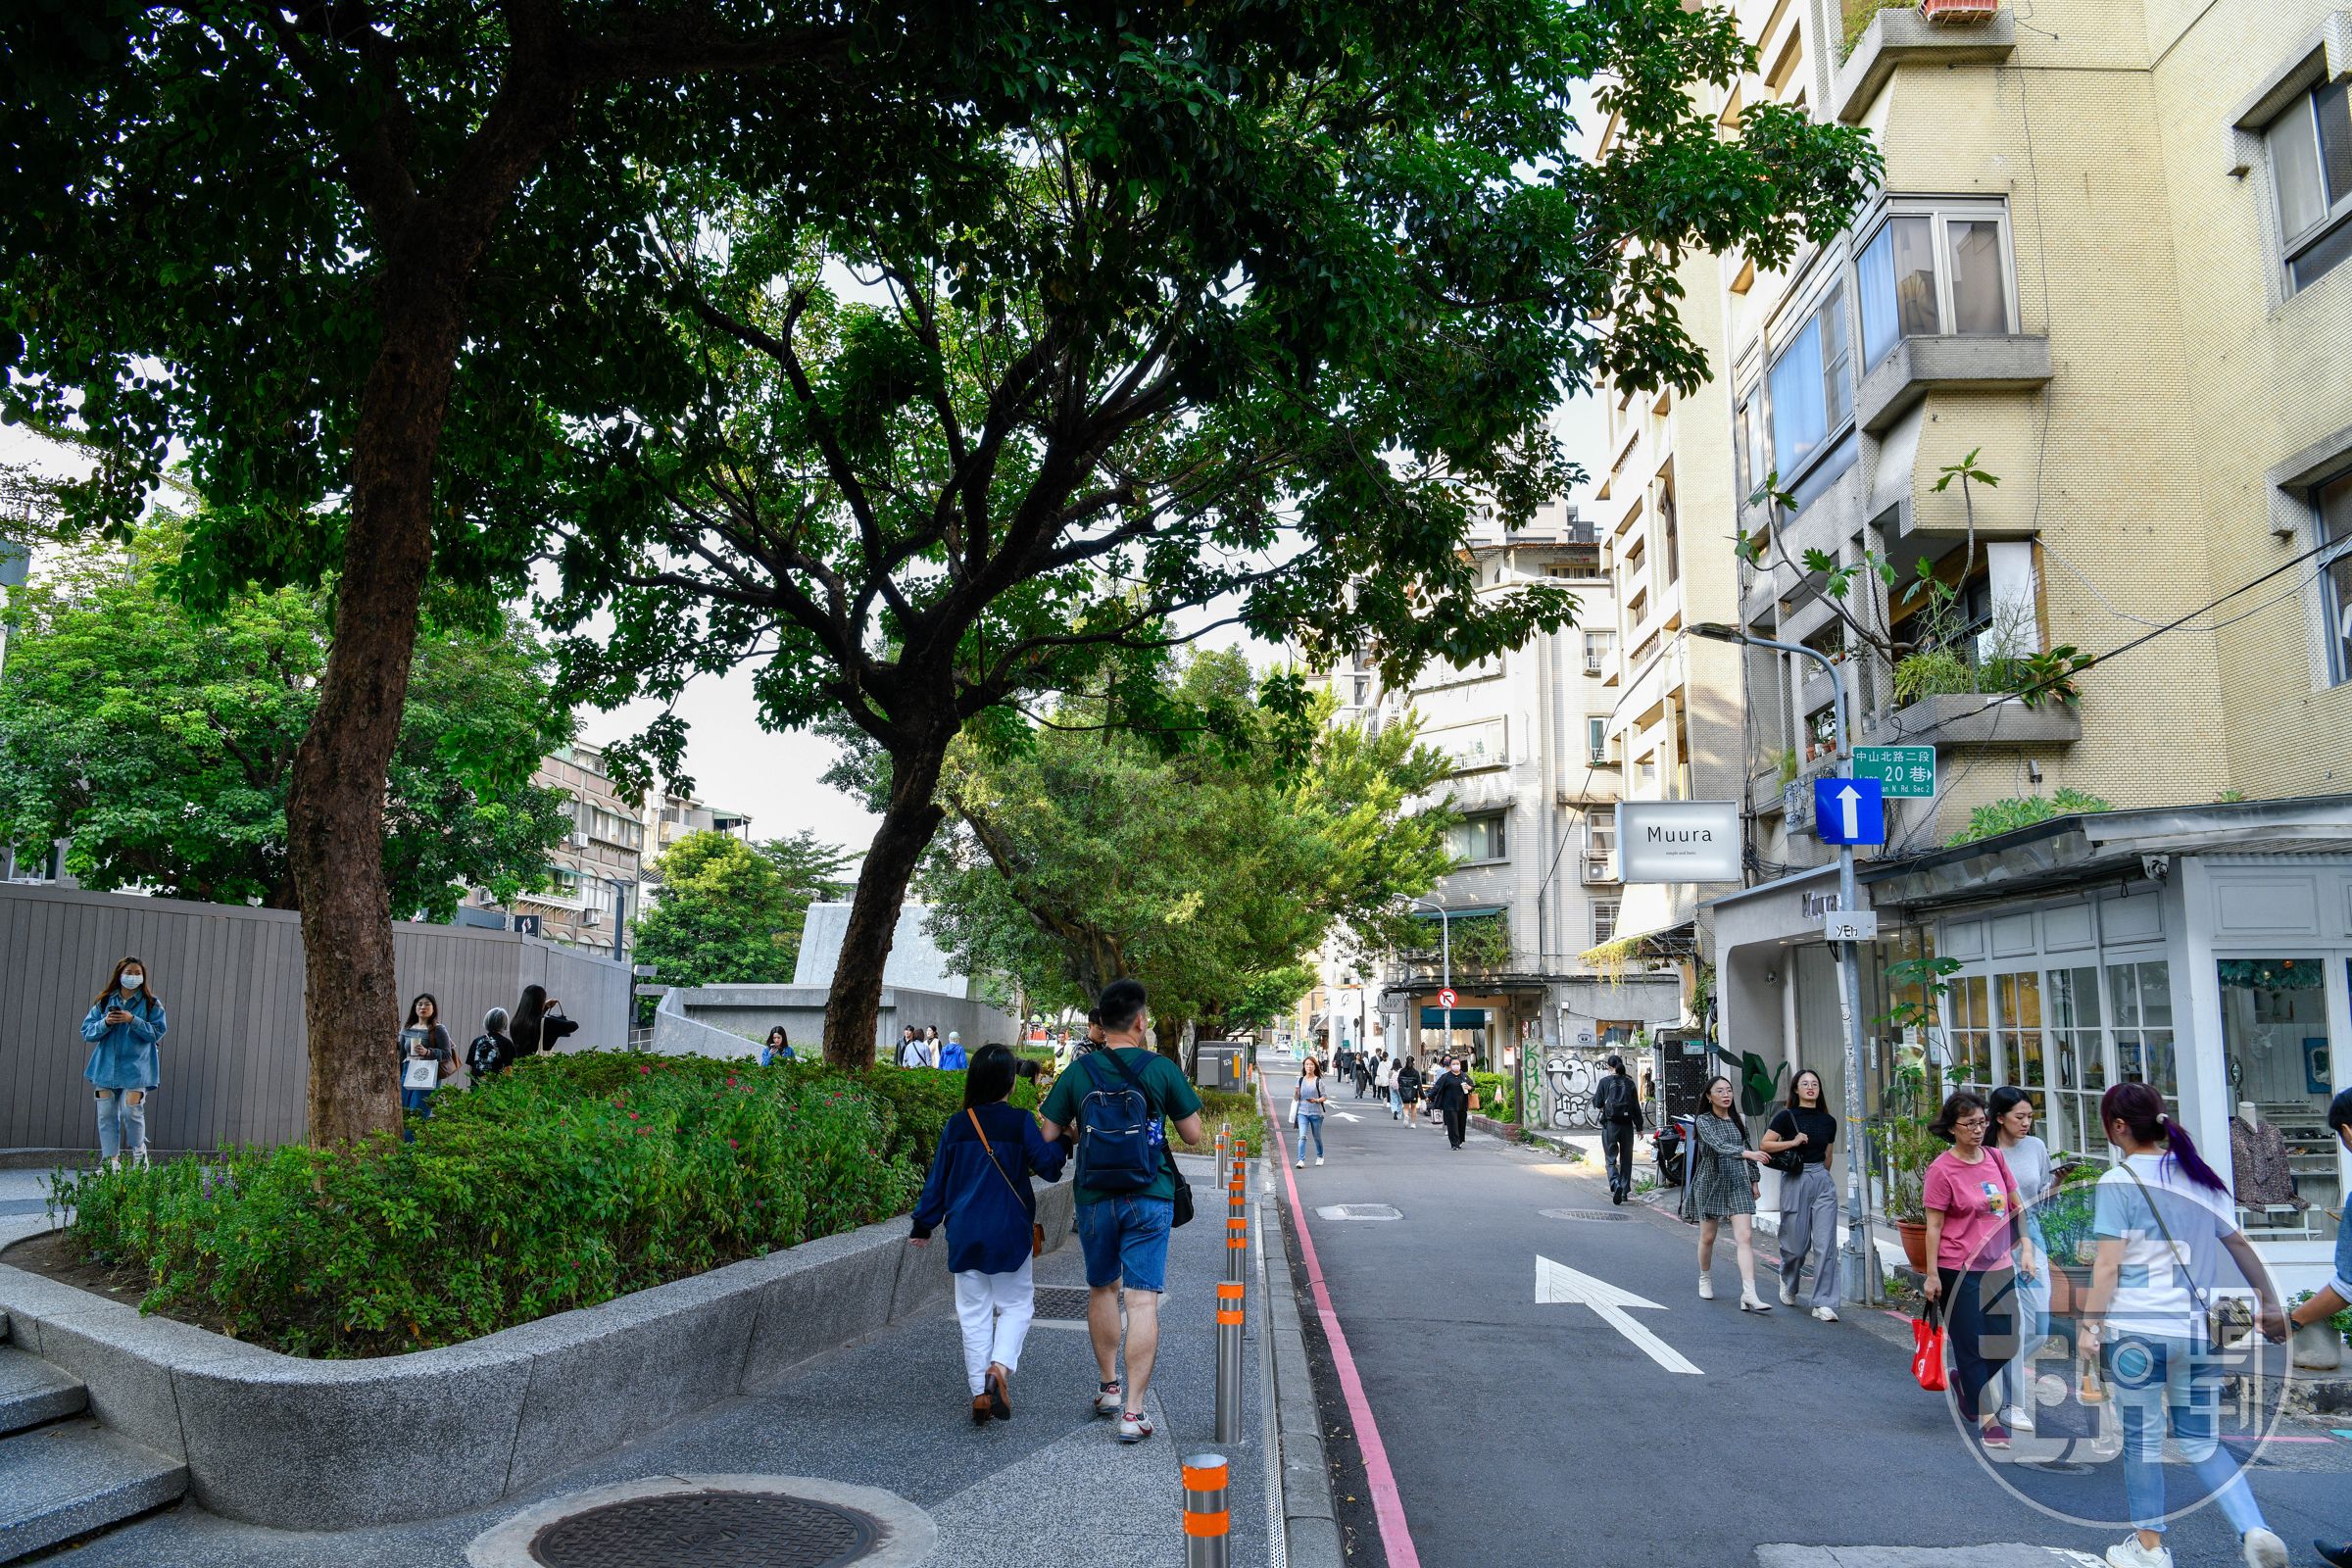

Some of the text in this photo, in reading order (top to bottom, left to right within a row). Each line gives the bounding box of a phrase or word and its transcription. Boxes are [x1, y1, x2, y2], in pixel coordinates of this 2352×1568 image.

[1856, 751, 1930, 762] 中山北路二段
[1885, 765, 1903, 782] 20
[1909, 765, 1927, 782] 巷
[1646, 826, 1712, 842] Muura
